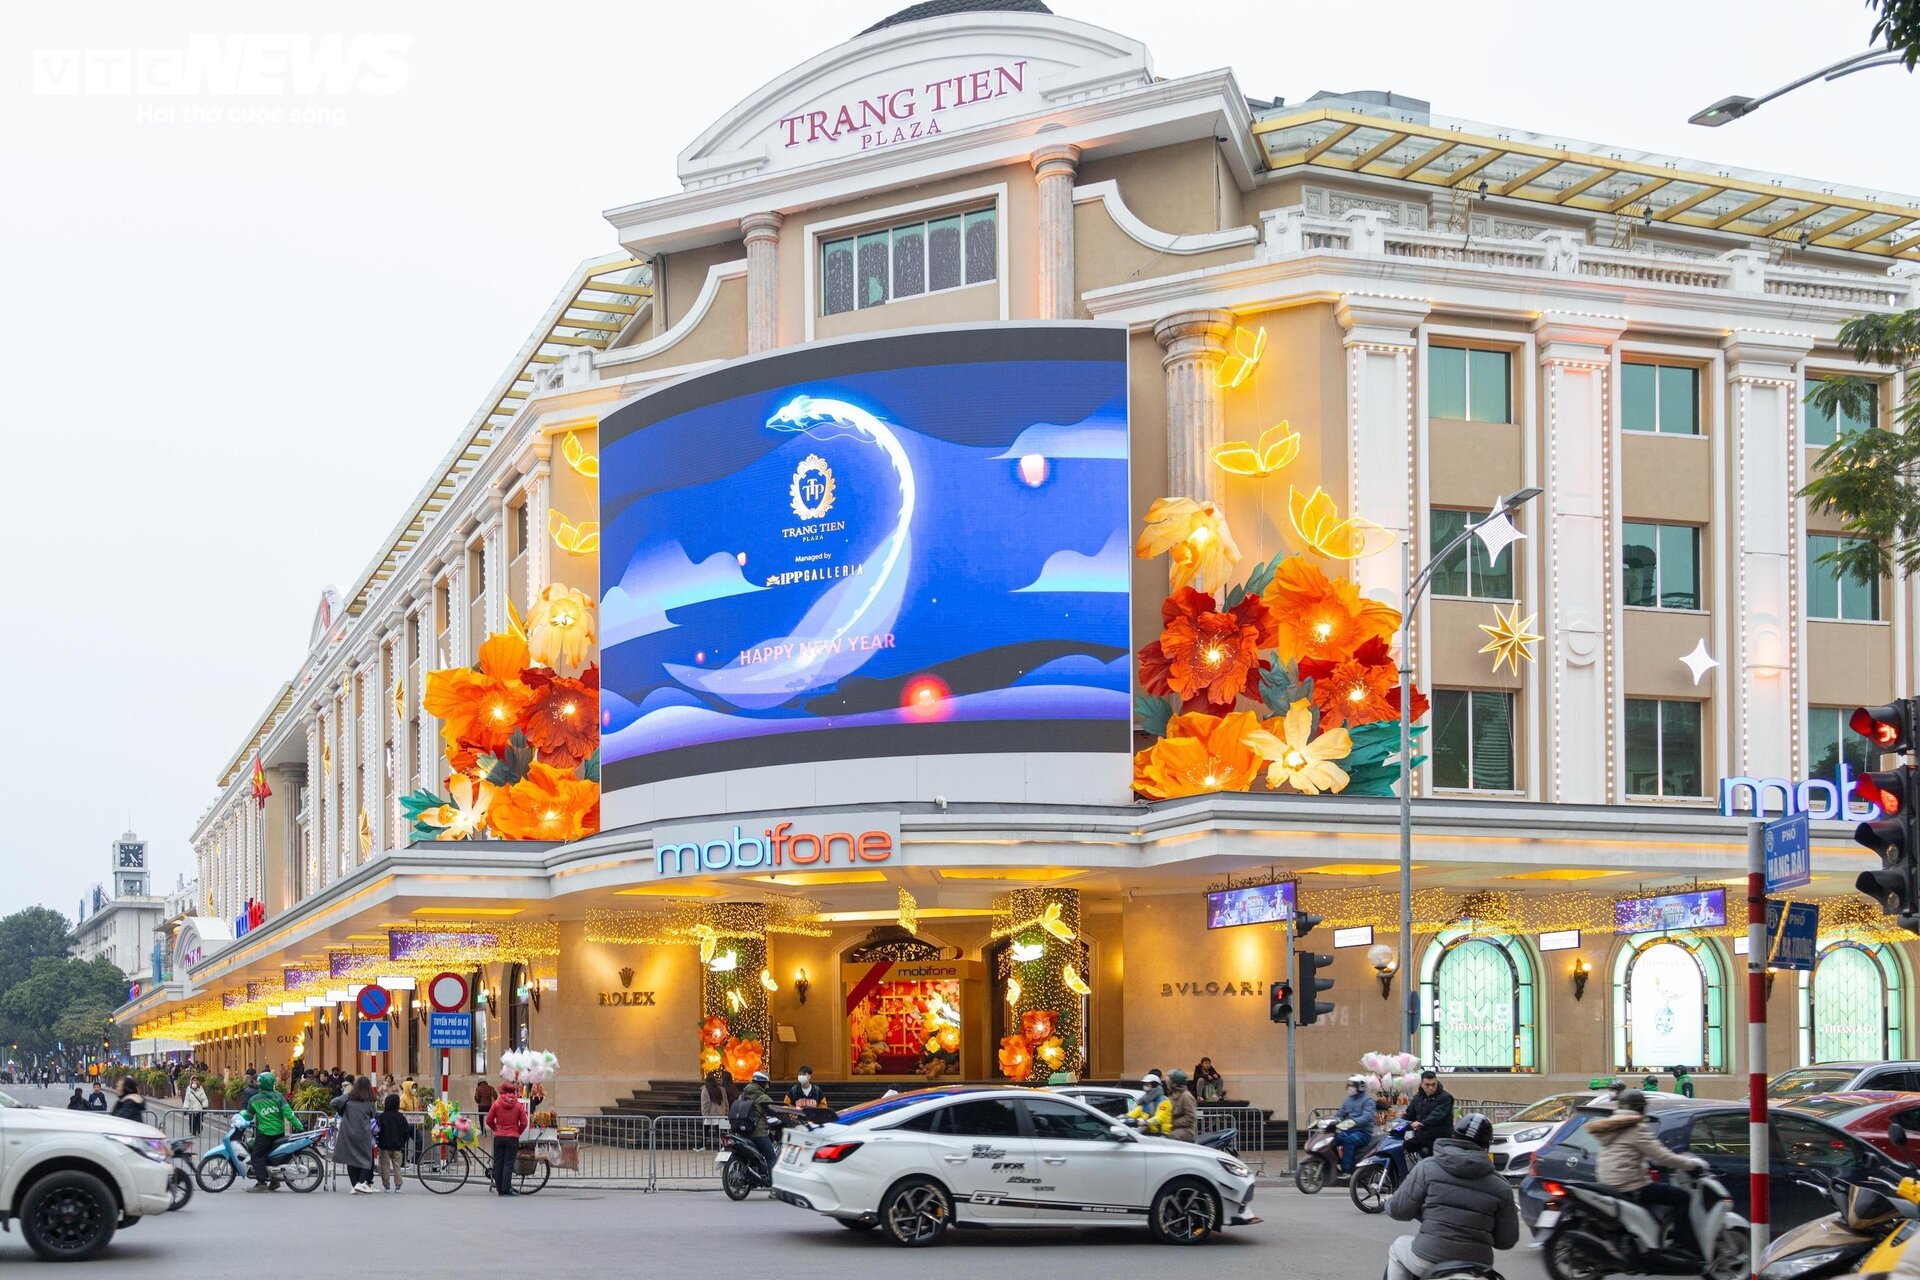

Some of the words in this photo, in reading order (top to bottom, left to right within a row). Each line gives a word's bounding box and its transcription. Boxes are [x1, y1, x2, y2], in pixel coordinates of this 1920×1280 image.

[780, 87, 917, 149] TRANG
[925, 61, 1028, 114] TIEN
[860, 118, 942, 151] PLAZA
[782, 524, 818, 538] TRANG
[818, 521, 846, 533] TIEN
[802, 535, 824, 543] PLAZA
[794, 552, 823, 563] Managed
[823, 552, 832, 560] by
[739, 643, 795, 666] HAPPY
[799, 637, 843, 658] NEW
[847, 633, 896, 652] YEAR
[1719, 762, 1883, 822] mob
[1781, 821, 1797, 843] PHỐ
[656, 822, 893, 874] mobifone
[1767, 852, 1791, 882] HÀNG
[897, 965, 957, 977] mobifone
[1160, 981, 1264, 997] BVLGARI
[599, 991, 656, 1007] ROLEX
[969, 1189, 1008, 1205] GT
